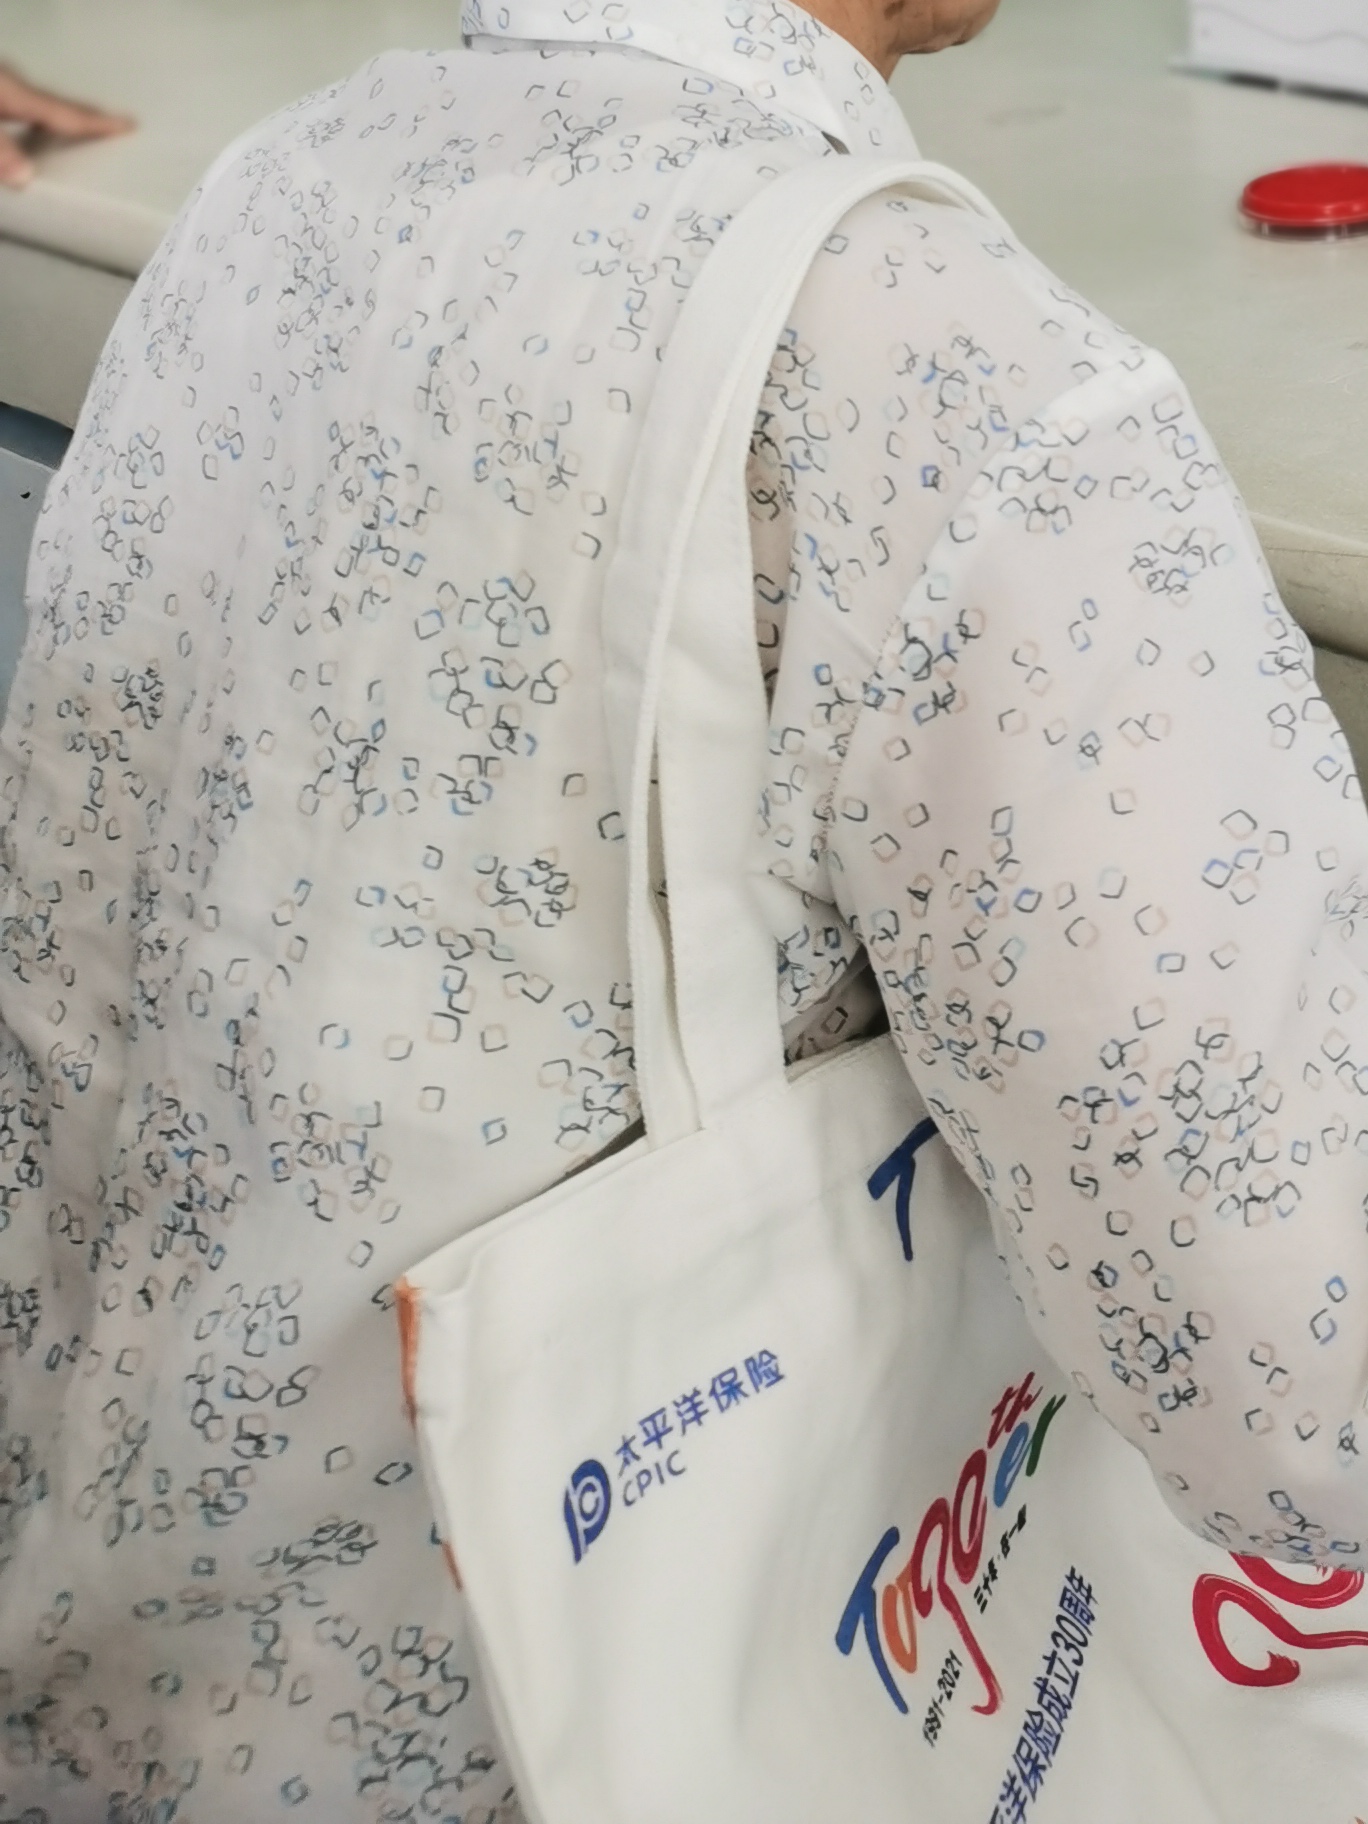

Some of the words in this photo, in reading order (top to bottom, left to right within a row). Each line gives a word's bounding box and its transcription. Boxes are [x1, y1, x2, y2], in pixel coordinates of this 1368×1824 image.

[615, 1348, 786, 1478] 太平洋保险
[622, 1449, 687, 1508] CPIC
[922, 1648, 963, 1749] 1991-2021
